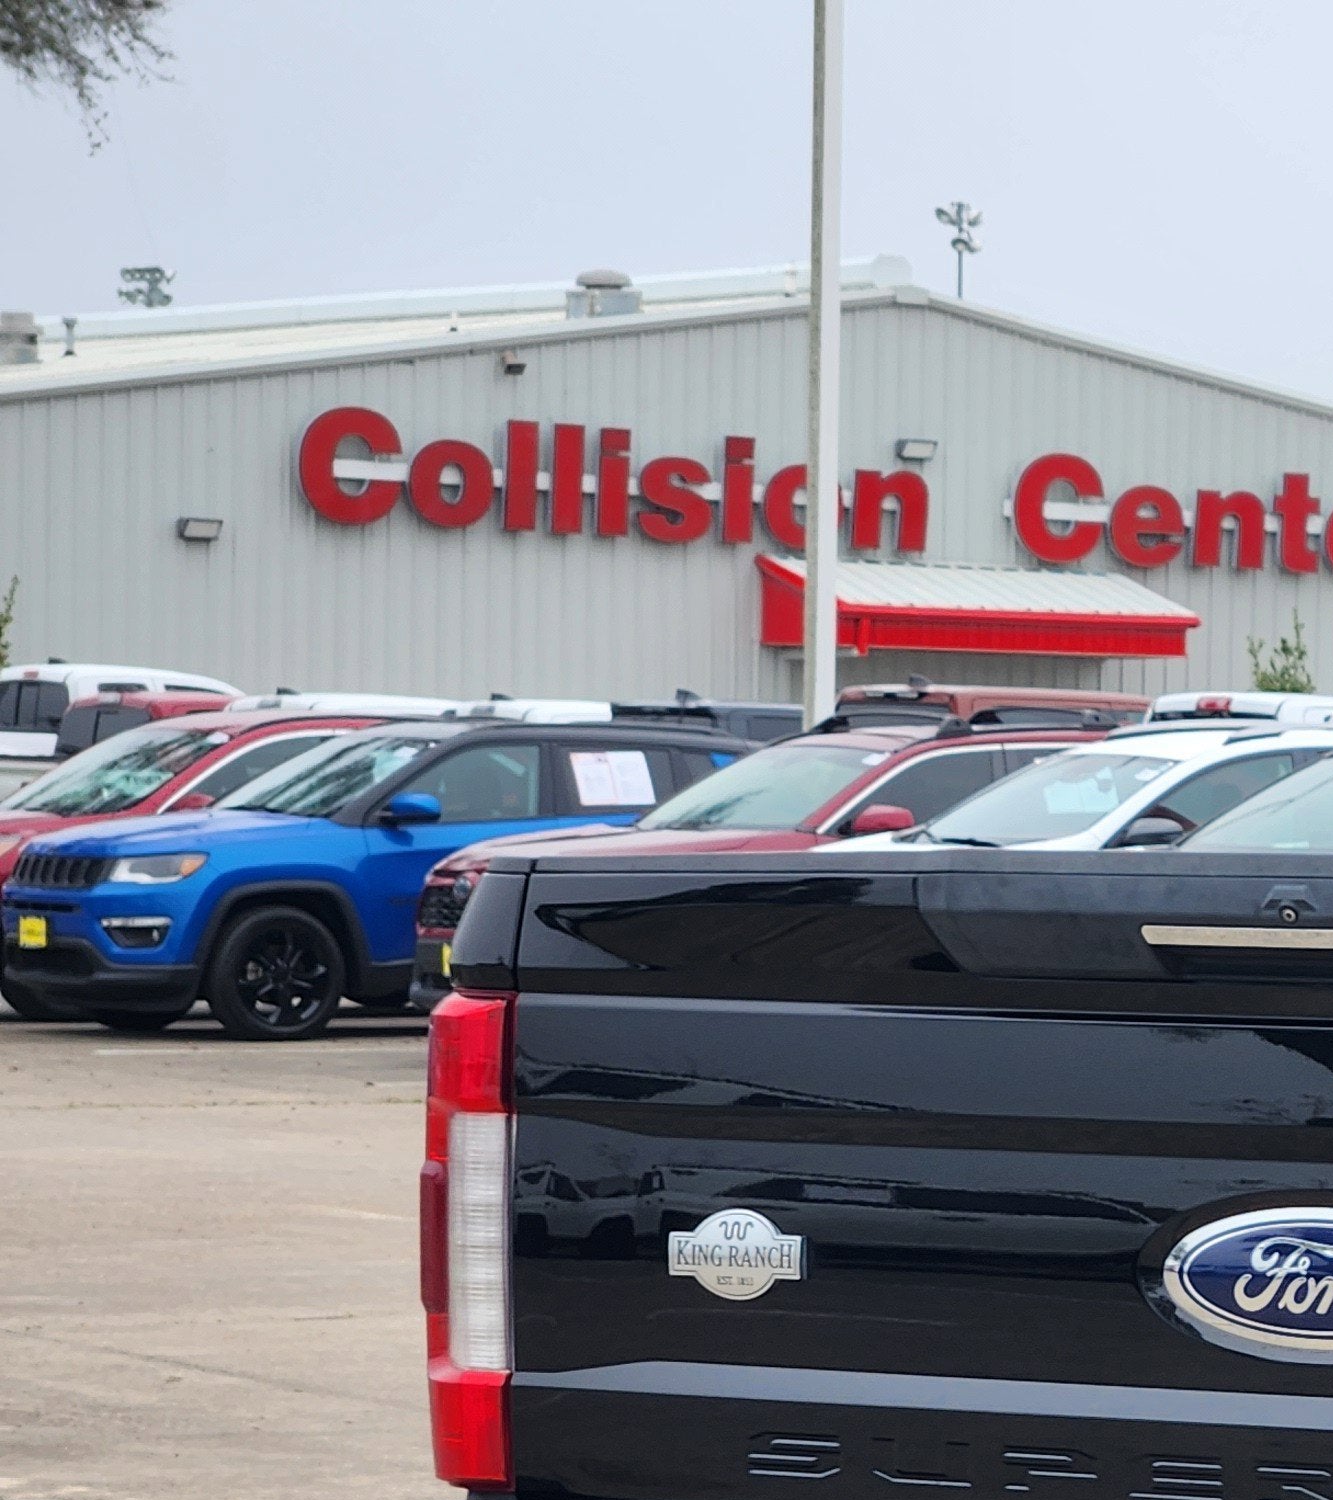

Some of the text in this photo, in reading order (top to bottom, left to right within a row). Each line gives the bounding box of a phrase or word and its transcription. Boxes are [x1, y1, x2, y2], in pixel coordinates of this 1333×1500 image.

[300, 407, 929, 552] Collision
[676, 1239, 793, 1269] KING RANCH
